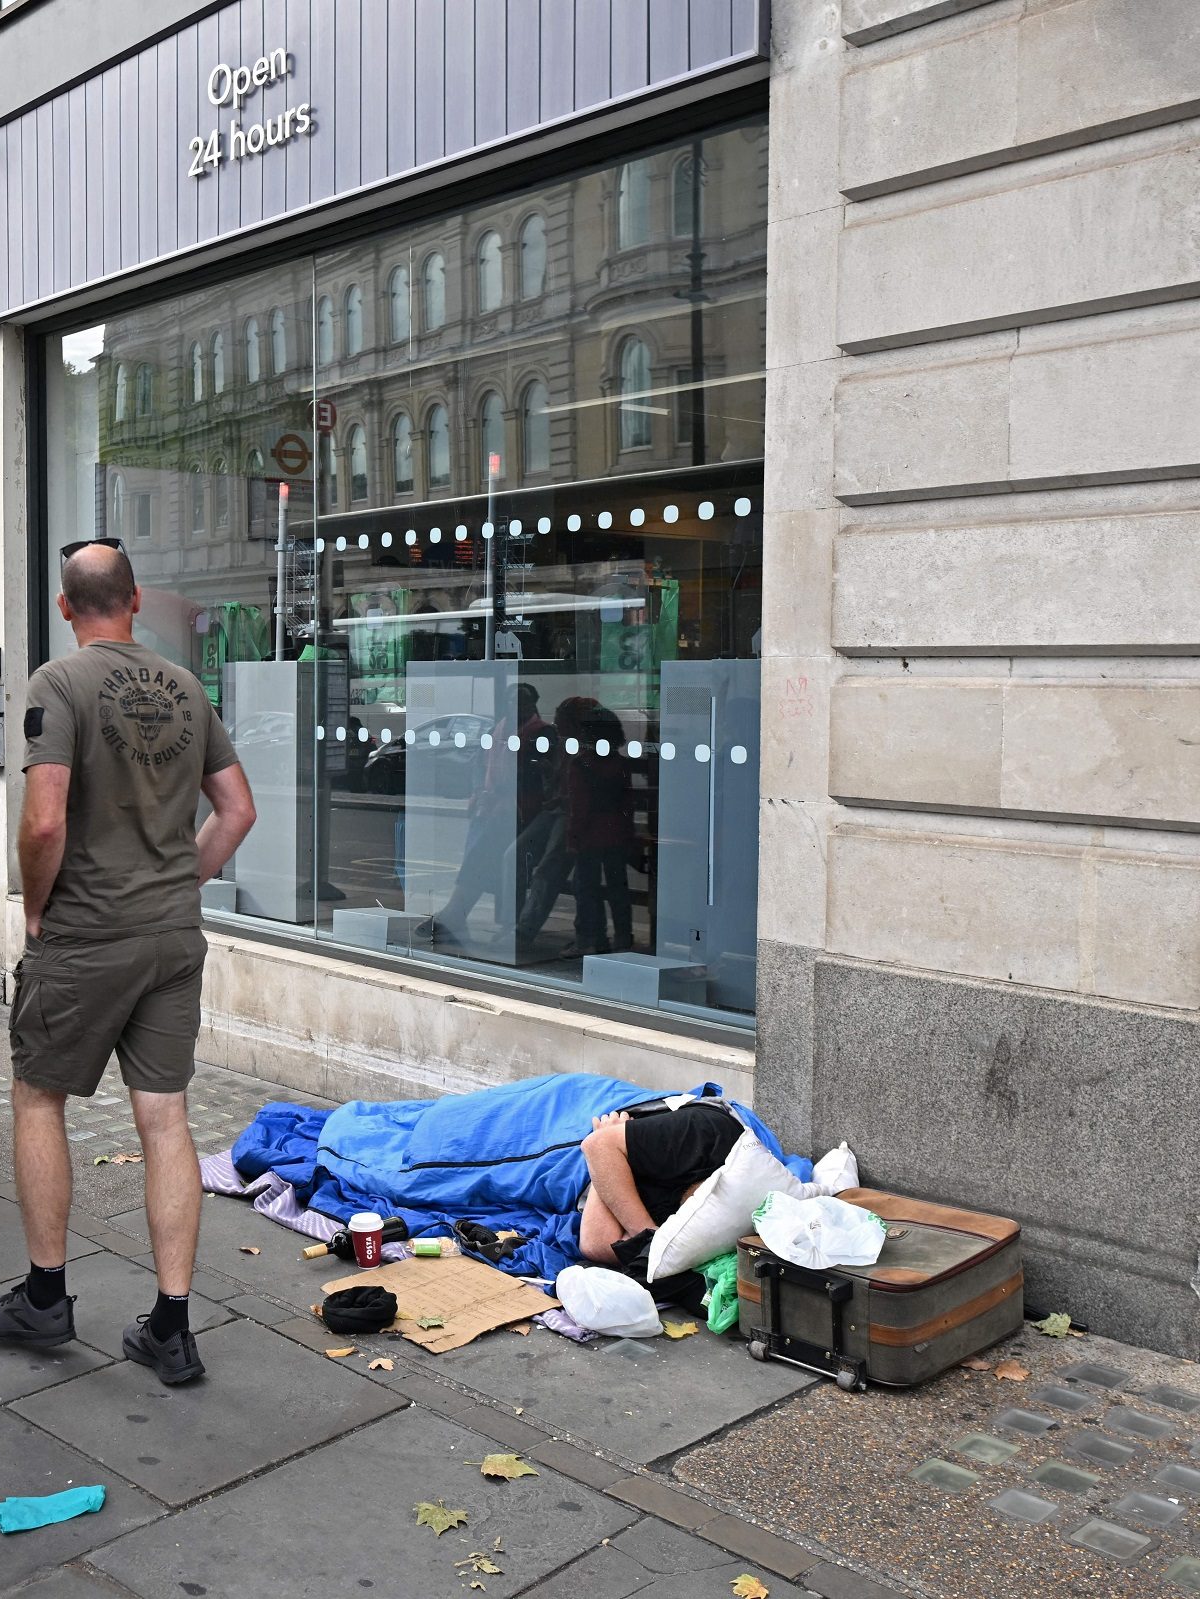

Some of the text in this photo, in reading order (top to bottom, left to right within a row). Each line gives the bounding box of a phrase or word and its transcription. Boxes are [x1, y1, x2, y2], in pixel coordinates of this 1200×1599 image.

[207, 48, 287, 110] Open
[187, 103, 311, 177] 24 hours
[182, 710, 193, 722] 18
[101, 724, 194, 767] BITE THE BULLET
[365, 1236, 373, 1260] COSTA
